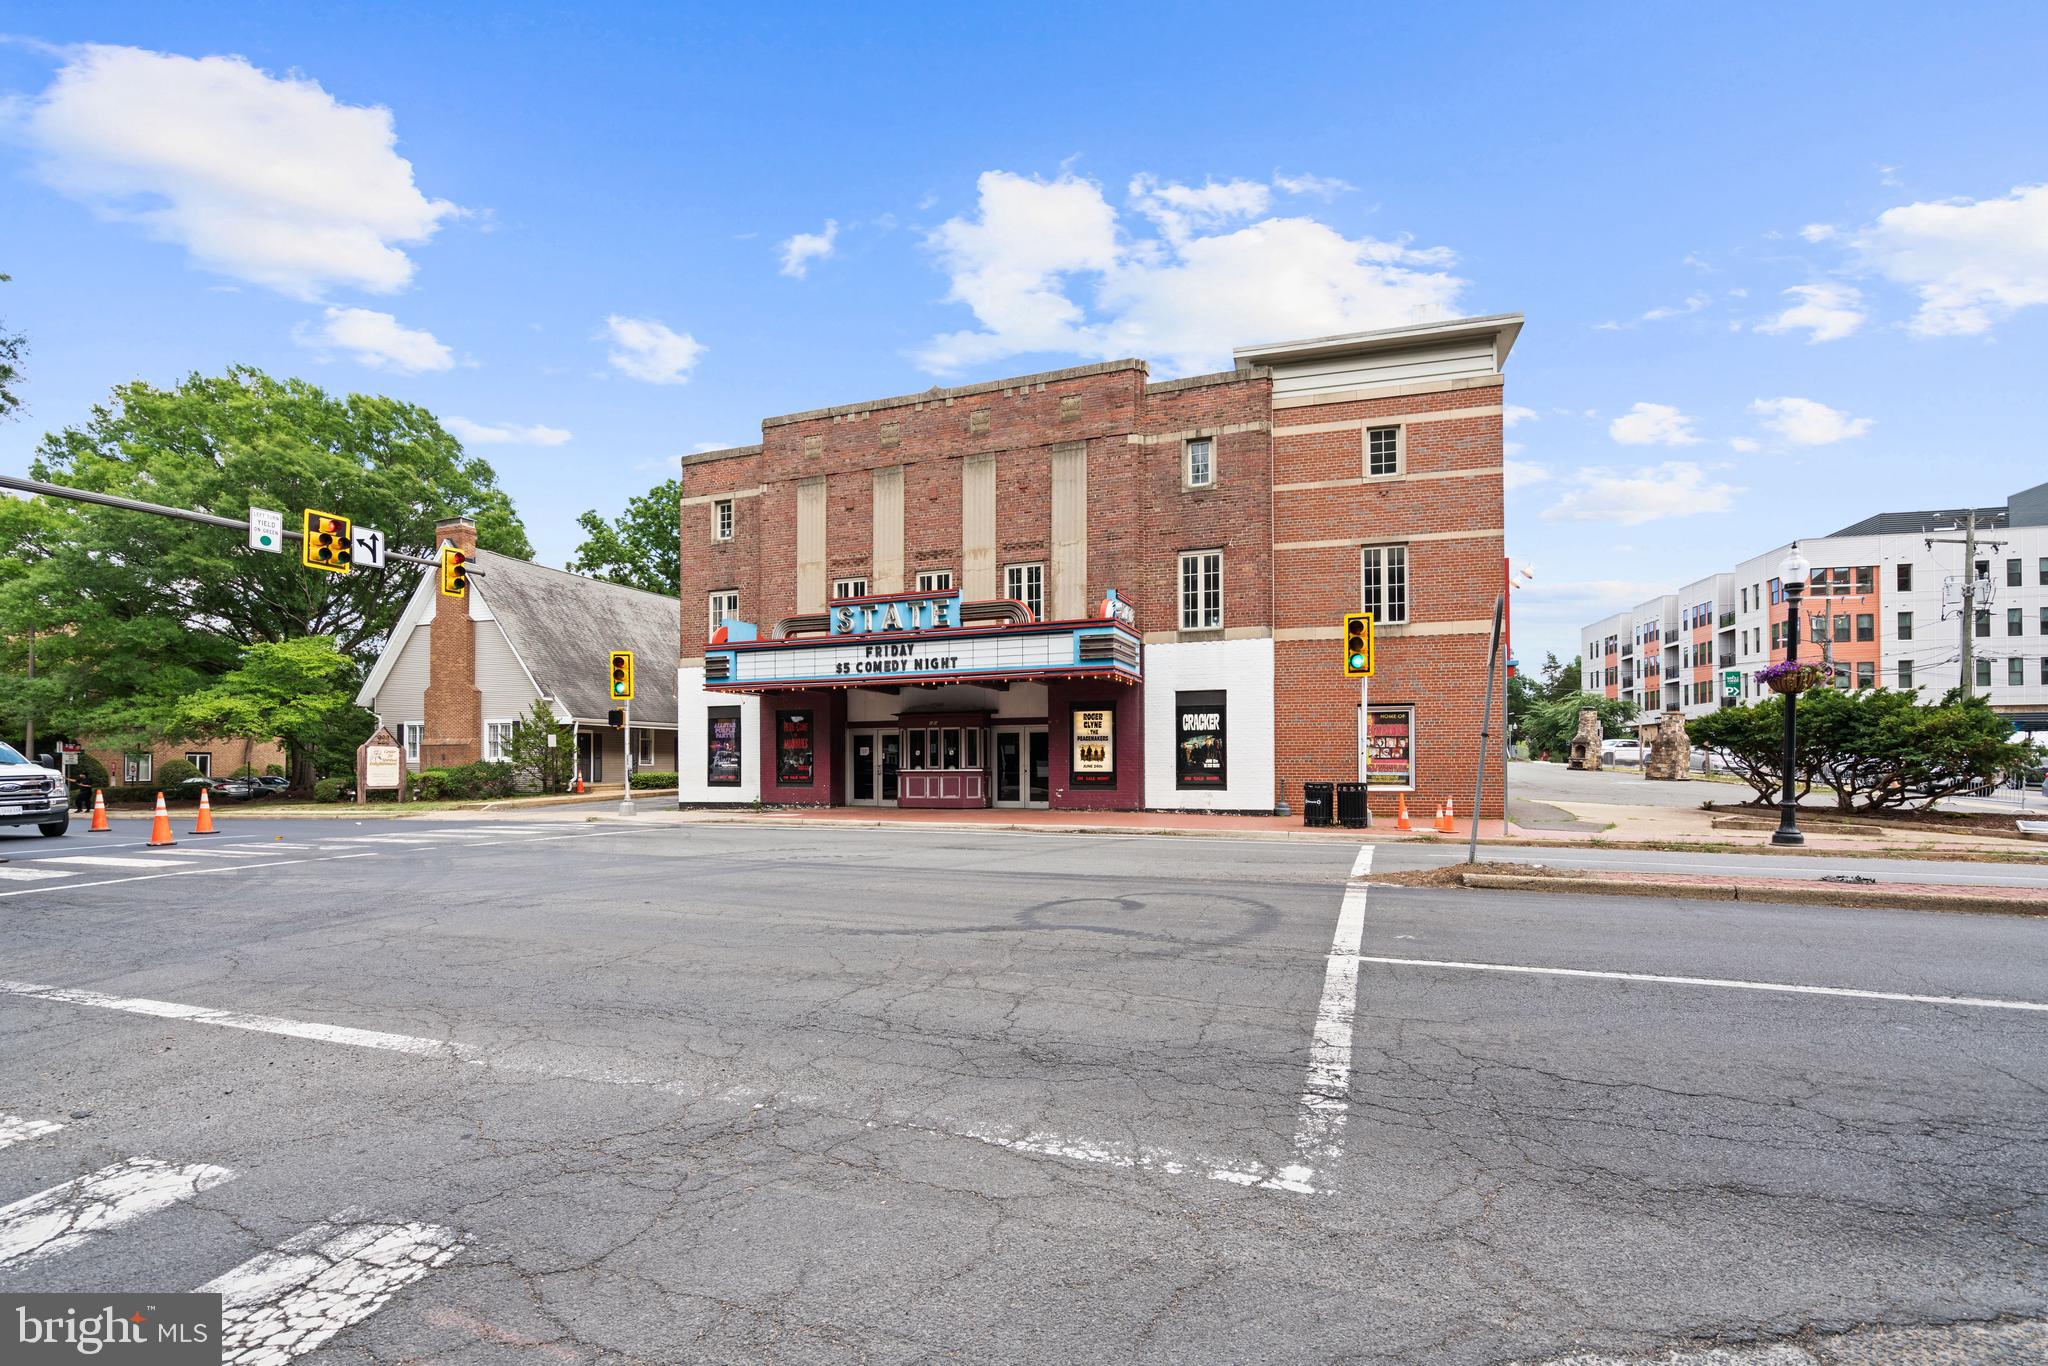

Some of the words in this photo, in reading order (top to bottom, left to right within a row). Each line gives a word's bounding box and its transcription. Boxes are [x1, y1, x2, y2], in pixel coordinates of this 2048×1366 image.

[257, 520, 276, 528] YIELD
[262, 528, 279, 536] GREEN
[836, 599, 951, 634] STATE
[865, 644, 914, 658] FRIDAY
[835, 662, 851, 674] $5
[856, 659, 908, 674] COMEDY
[914, 657, 958, 670] NIGHT
[1182, 713, 1220, 731] CRACKER
